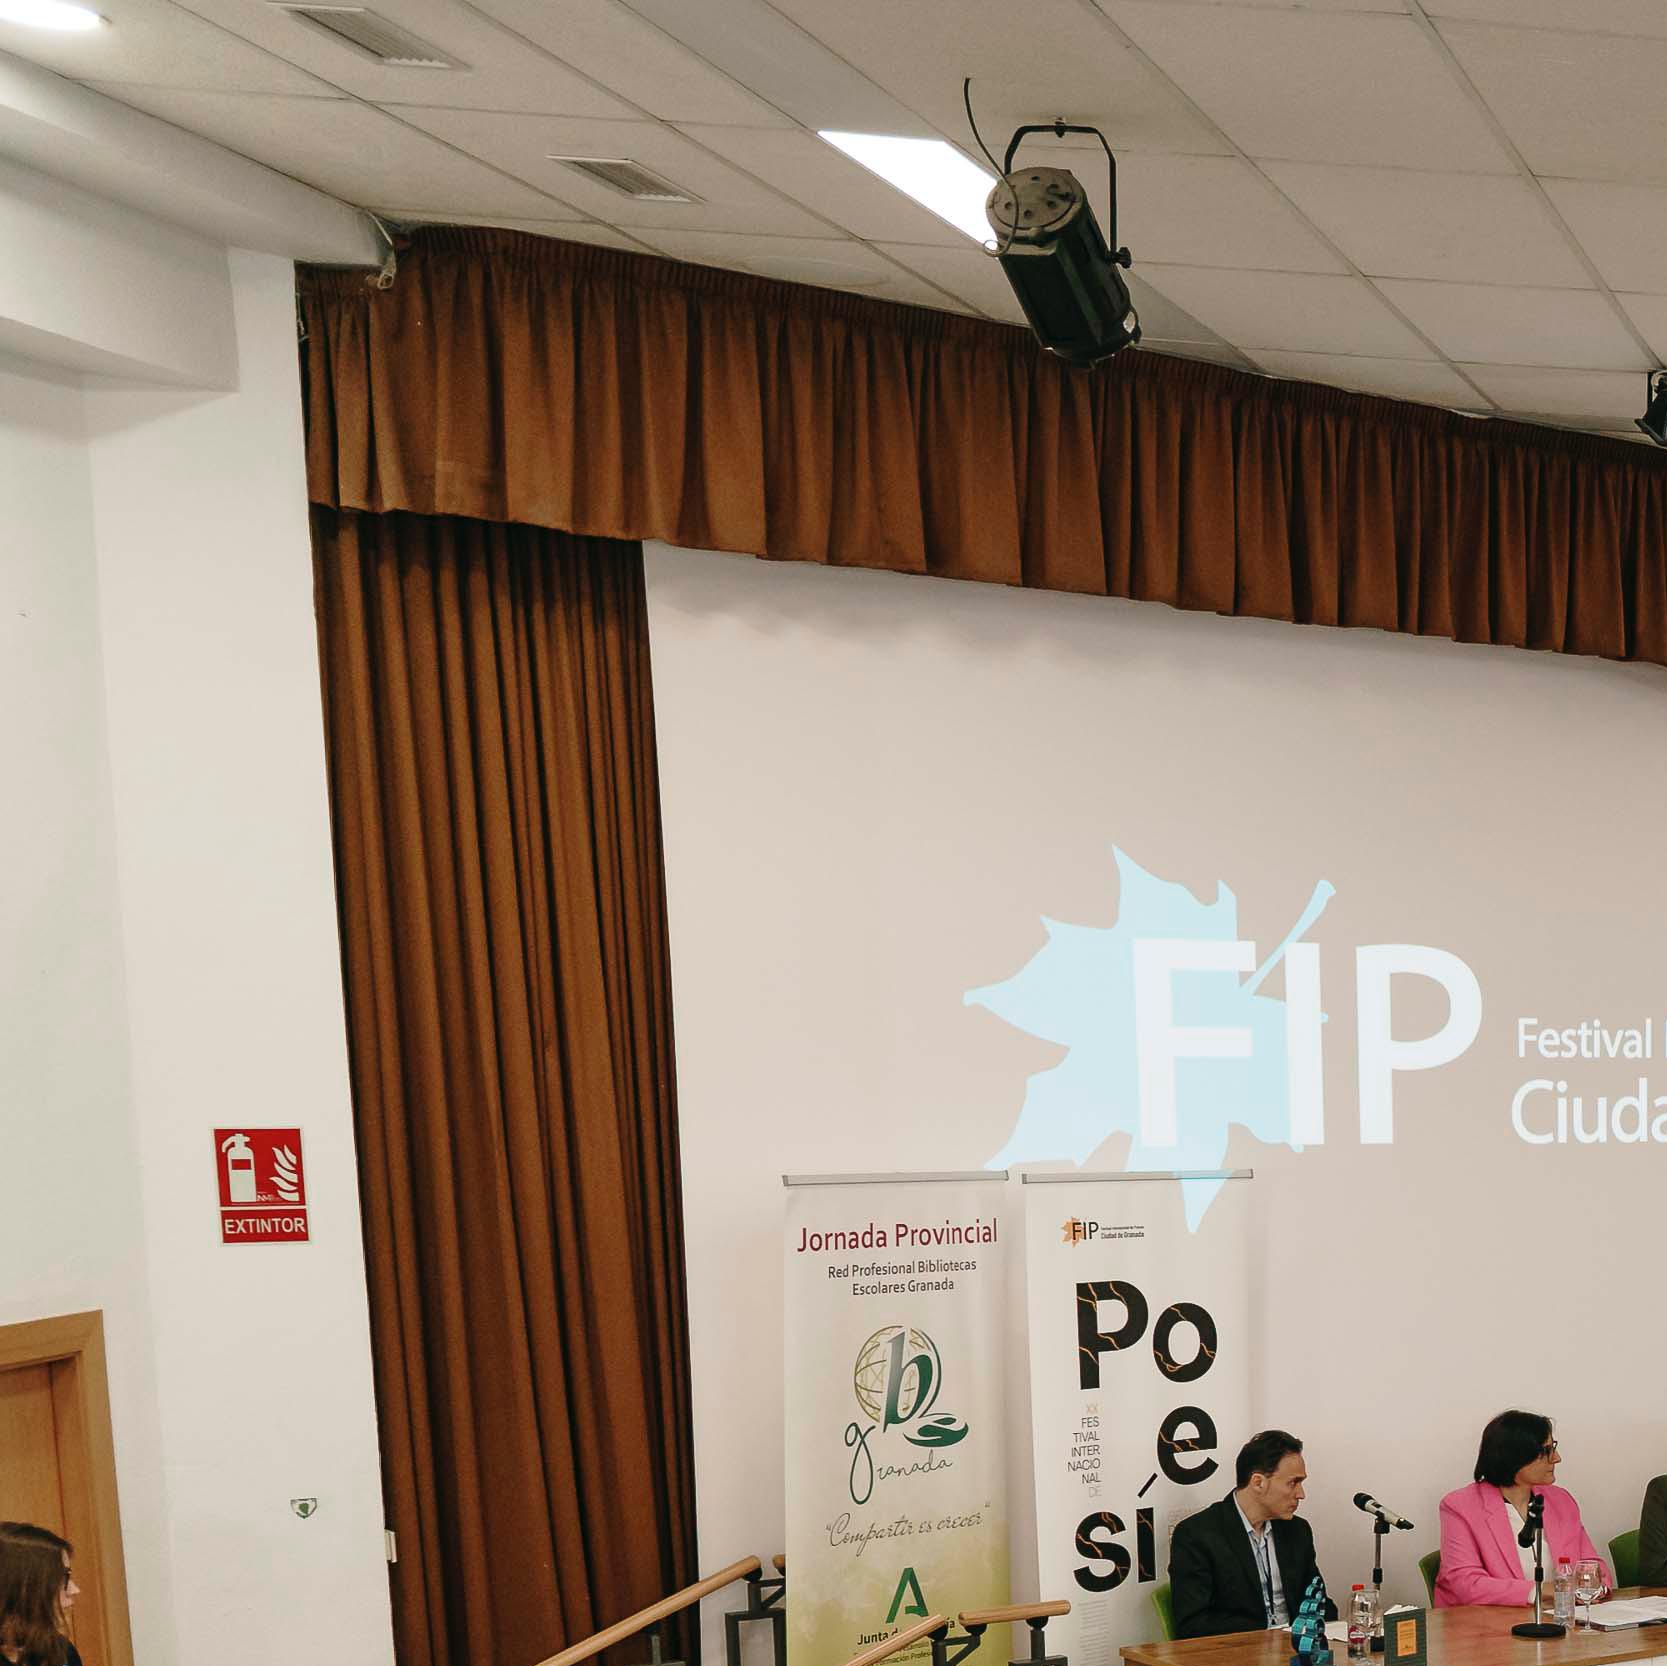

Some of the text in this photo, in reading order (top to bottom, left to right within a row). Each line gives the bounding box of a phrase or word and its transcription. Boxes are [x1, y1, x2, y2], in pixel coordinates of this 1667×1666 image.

[1133, 938, 1482, 1147] FIP
[1517, 1017, 1652, 1059] Festival
[225, 1217, 306, 1234] EXTINTOR
[797, 1217, 998, 1252] Jornada Provincial
[1072, 1221, 1099, 1240] FIP
[828, 1259, 977, 1279] Red Profesional Bibliotecas
[852, 1277, 955, 1296] Escolares Granada
[1075, 1280, 1217, 1391] Po
[1081, 1416, 1100, 1428] FES
[1072, 1431, 1100, 1444] TIVAL
[1157, 1406, 1219, 1485] e
[1071, 1445, 1100, 1457] INTER
[1067, 1458, 1100, 1472] NACIO
[1082, 1473, 1101, 1484] NAL
[857, 1631, 889, 1645] Junta
